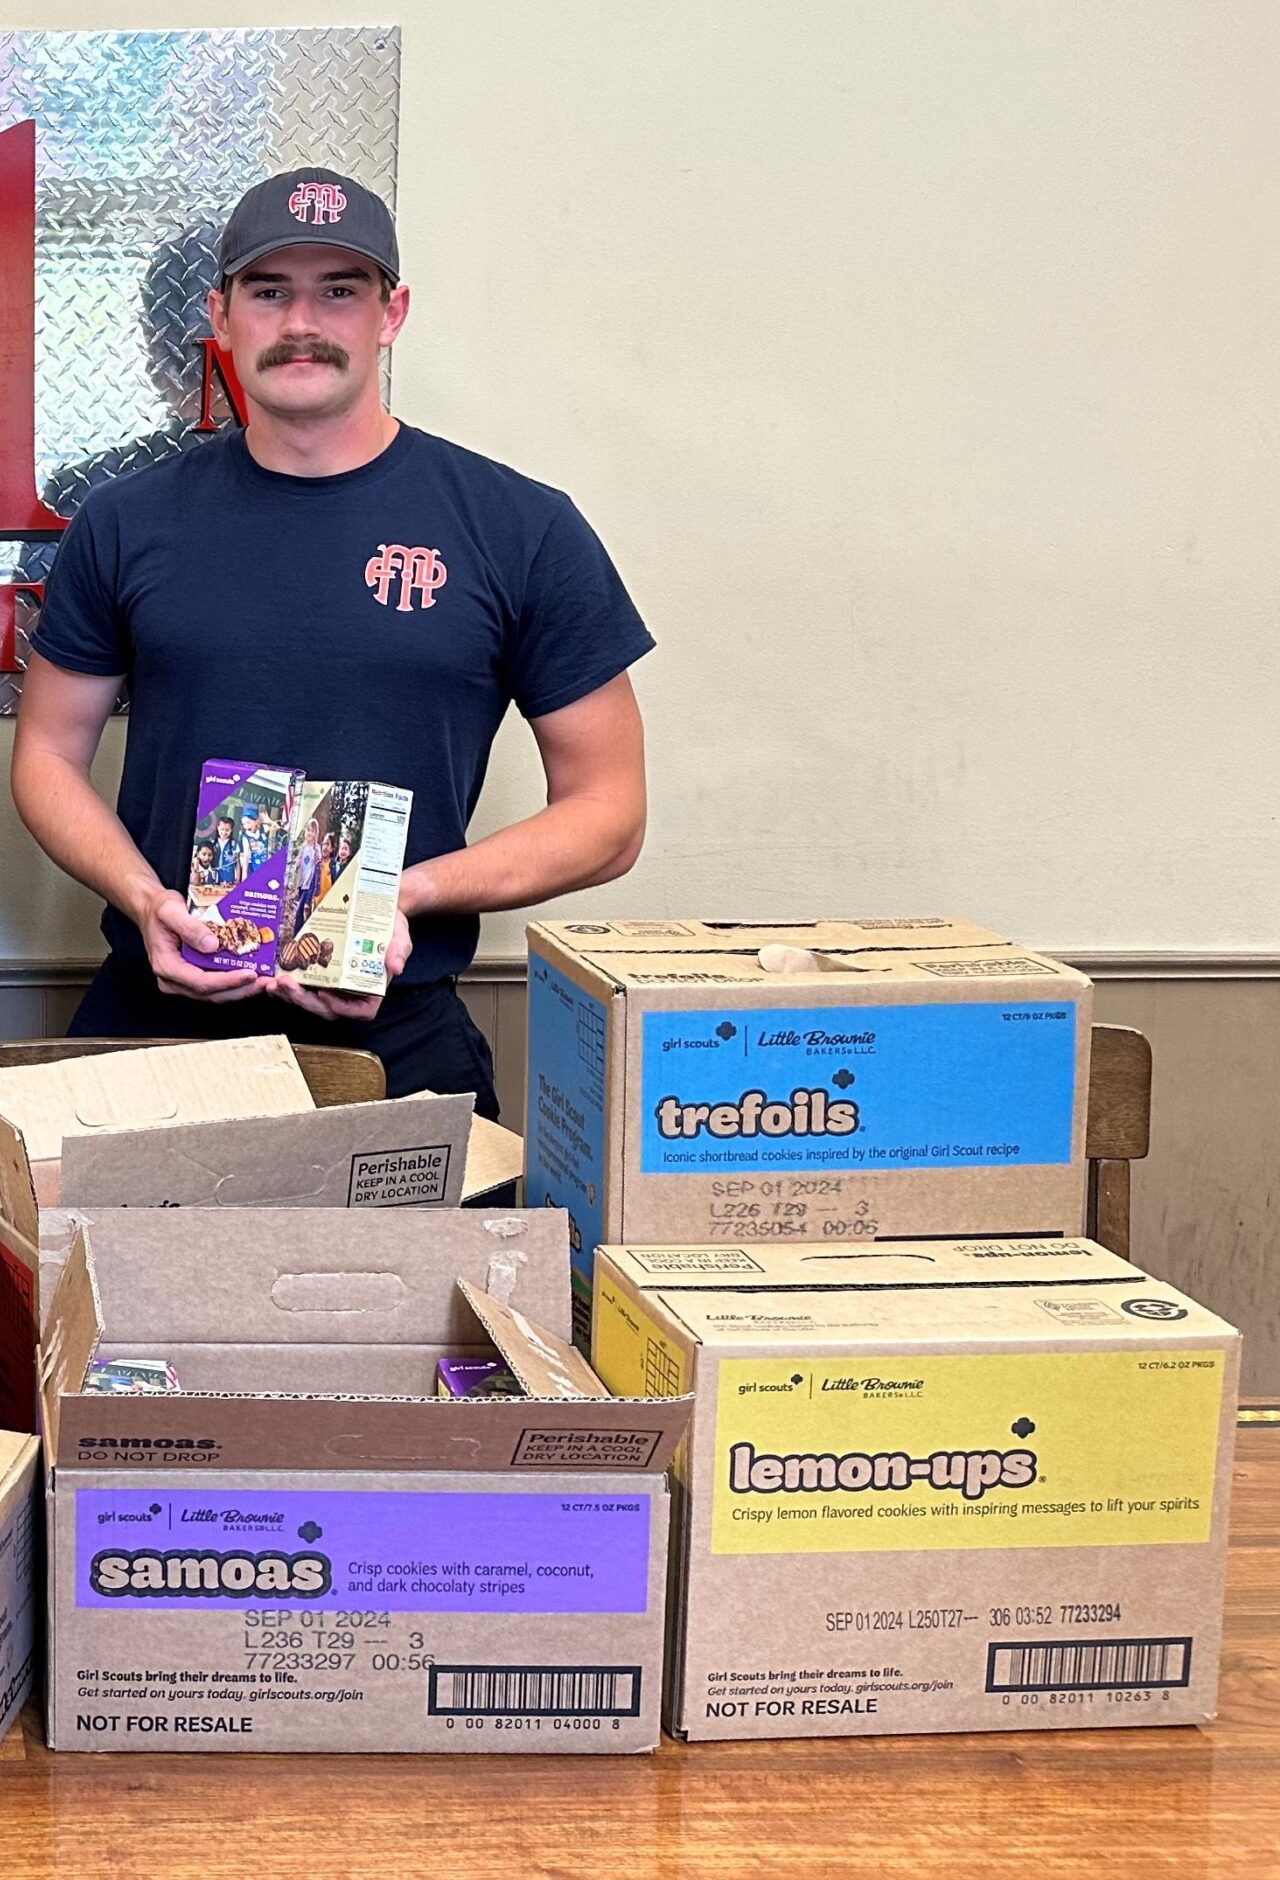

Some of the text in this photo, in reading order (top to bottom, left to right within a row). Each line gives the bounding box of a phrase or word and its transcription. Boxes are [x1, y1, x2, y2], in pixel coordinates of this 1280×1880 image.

[662, 1038, 720, 1051] girl scouts
[757, 1030, 876, 1046] Little Brownie
[655, 1088, 860, 1140] trefoils
[663, 1143, 1020, 1163] Iconic shortbread cookies inspired by the original Girl Scout recipe
[358, 1154, 442, 1176] Perishable
[356, 1171, 440, 1189] KEEP IN A COOL
[712, 1181, 754, 1197] SEP
[355, 1184, 438, 1202] DRY LOCATION
[738, 1383, 793, 1395] girl scouts
[821, 1377, 924, 1391] Little Brownie
[729, 1441, 1038, 1500] lemon-ups
[732, 1497, 1200, 1523] Crispy lemon flavored cookies with inspiring messages to lift your spirits
[89, 1548, 332, 1599] samoas
[348, 1561, 594, 1579] Crisp cookies with caramel, coconut,
[348, 1580, 525, 1597] and dark chocolaty stripes
[244, 1609, 391, 1629] SEP 01 2024
[826, 1612, 853, 1631] SEP
[856, 1612, 870, 1630] 01
[873, 1611, 903, 1630] 2024
[1016, 1606, 1052, 1625] 03:52
[1060, 1603, 1121, 1624] 77233294
[244, 1631, 355, 1649] L236 T29
[244, 1652, 436, 1671] 77233297 00:56
[77, 1670, 298, 1684] Girl Scouts bring their dreams to life.
[705, 1698, 878, 1718] NOT FOR RESALE
[76, 1714, 253, 1734] NOT FOR RESALE
